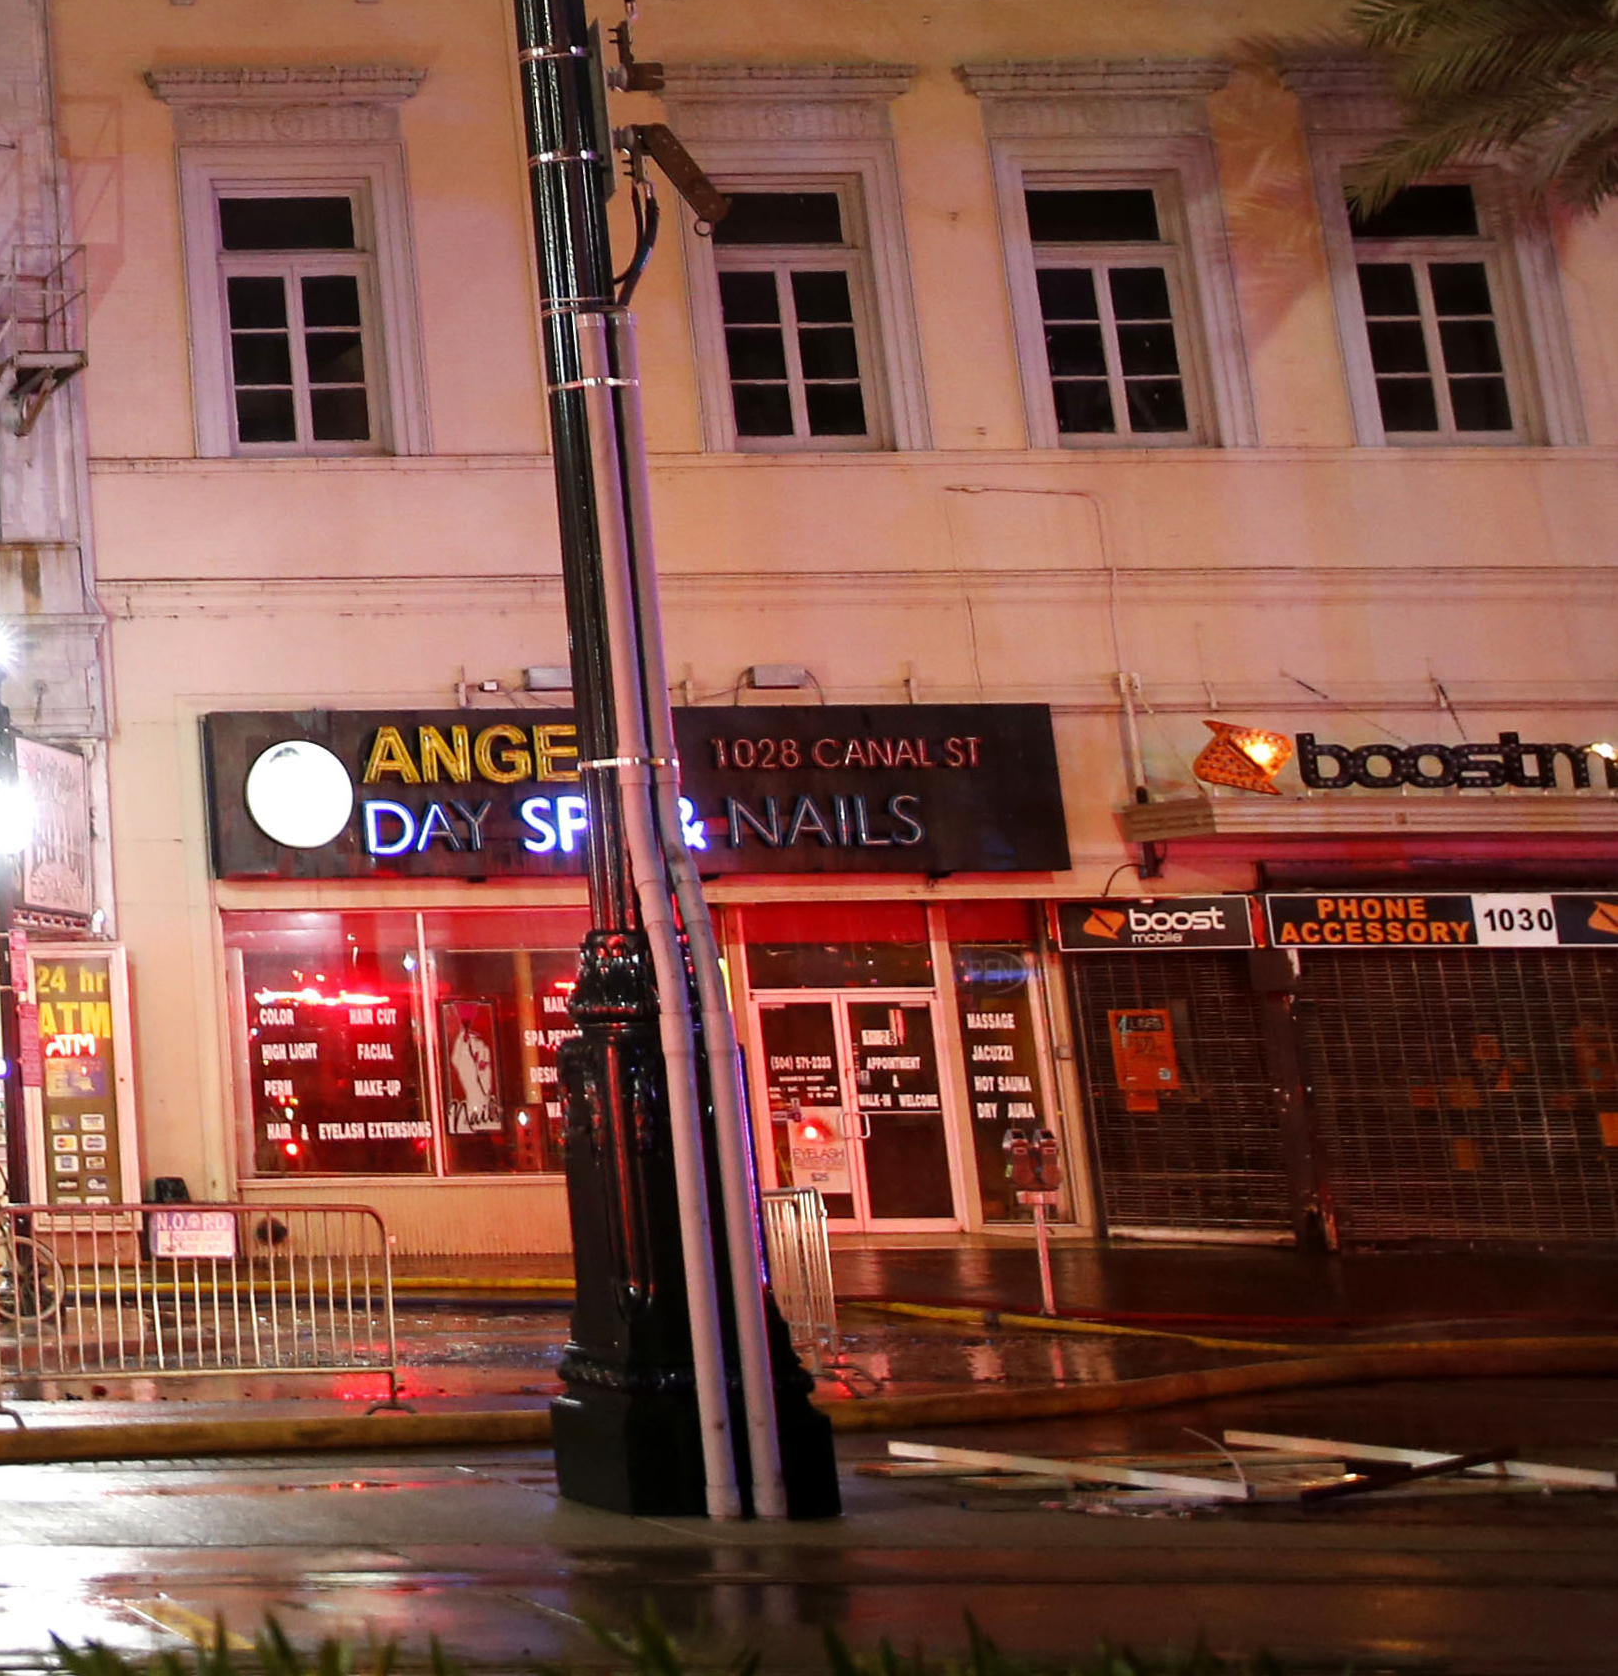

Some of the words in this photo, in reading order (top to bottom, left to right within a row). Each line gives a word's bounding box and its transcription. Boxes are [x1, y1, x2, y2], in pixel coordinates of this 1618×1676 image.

[363, 725, 581, 784] ANGE
[709, 736, 802, 772] 1028
[813, 735, 938, 770] CANAL
[945, 735, 982, 769] ST
[365, 799, 490, 855] DAY
[522, 795, 588, 855] SP
[729, 794, 925, 849] NAILS
[1316, 897, 1426, 920] PHONE
[1129, 906, 1225, 933] boost
[1483, 907, 1553, 933] 1030
[1132, 932, 1182, 944] mobile
[1280, 920, 1469, 944] ACCESSORY
[36, 965, 67, 994] 24
[79, 965, 108, 994] hr
[542, 995, 569, 1013] NAIL
[38, 1001, 111, 1039] ATM
[259, 1008, 295, 1025] COLOR
[349, 1008, 374, 1025] HAIR
[376, 1007, 397, 1025] CUT
[966, 1013, 1016, 1029] MASSAGE
[45, 1032, 96, 1057] ATM
[524, 1029, 545, 1047] SPA
[865, 1030, 895, 1044] 128
[262, 1043, 288, 1061] HIGH
[289, 1043, 318, 1060] LIGHT
[357, 1044, 394, 1060] FACIAL
[972, 1045, 1014, 1062] JACUZZI
[866, 1056, 921, 1070] APPOINTMENT
[264, 1080, 294, 1097] PERM
[354, 1080, 402, 1097] MAKE-UP
[974, 1076, 996, 1092] HOT
[997, 1076, 1033, 1092] SAUNA
[858, 1093, 892, 1107] WALK-IN
[898, 1094, 939, 1108] WELCOME
[976, 1103, 998, 1119] DRY
[267, 1123, 292, 1140] HAIR
[318, 1123, 365, 1140] EYELASH
[368, 1121, 432, 1139] EXTENSIONS
